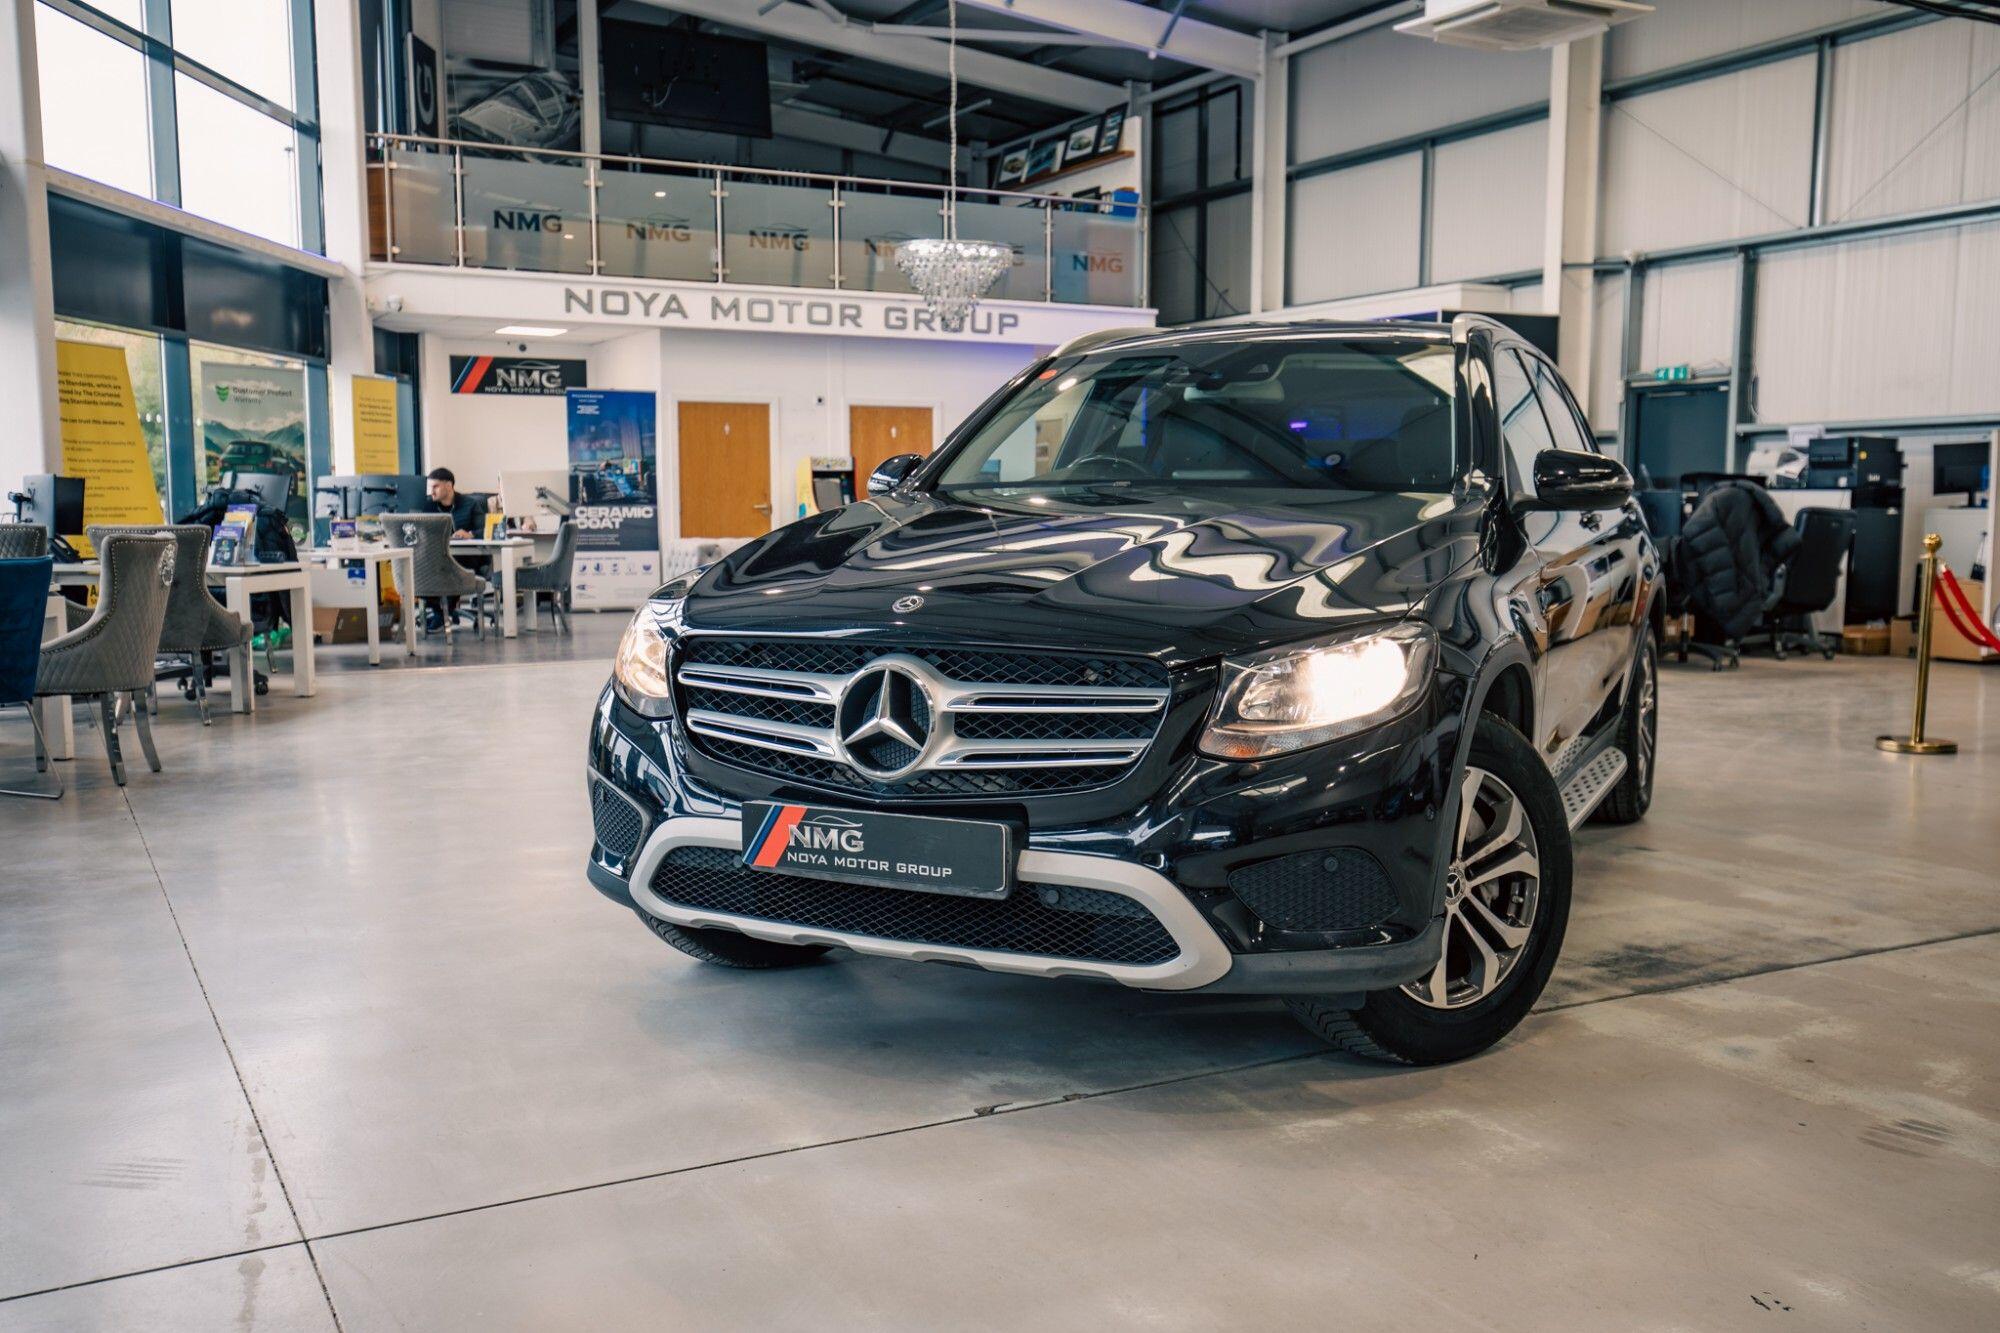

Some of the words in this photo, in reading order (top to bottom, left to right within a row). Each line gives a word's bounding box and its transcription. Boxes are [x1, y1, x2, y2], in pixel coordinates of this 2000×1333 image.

[493, 210, 562, 233] NMG
[625, 222, 691, 242] NMG
[749, 229, 811, 252] NMG
[1072, 253, 1123, 273] NMG
[564, 287, 688, 319] NOYA
[711, 296, 863, 328] MOTOR
[884, 306, 1019, 335] GROUP
[495, 367, 562, 388] NMG
[575, 506, 654, 519] CERAMIC
[787, 824, 865, 853] NMG
[786, 851, 828, 866] NOYA
[834, 856, 890, 872] MOTOR
[896, 862, 953, 878] GROUP
